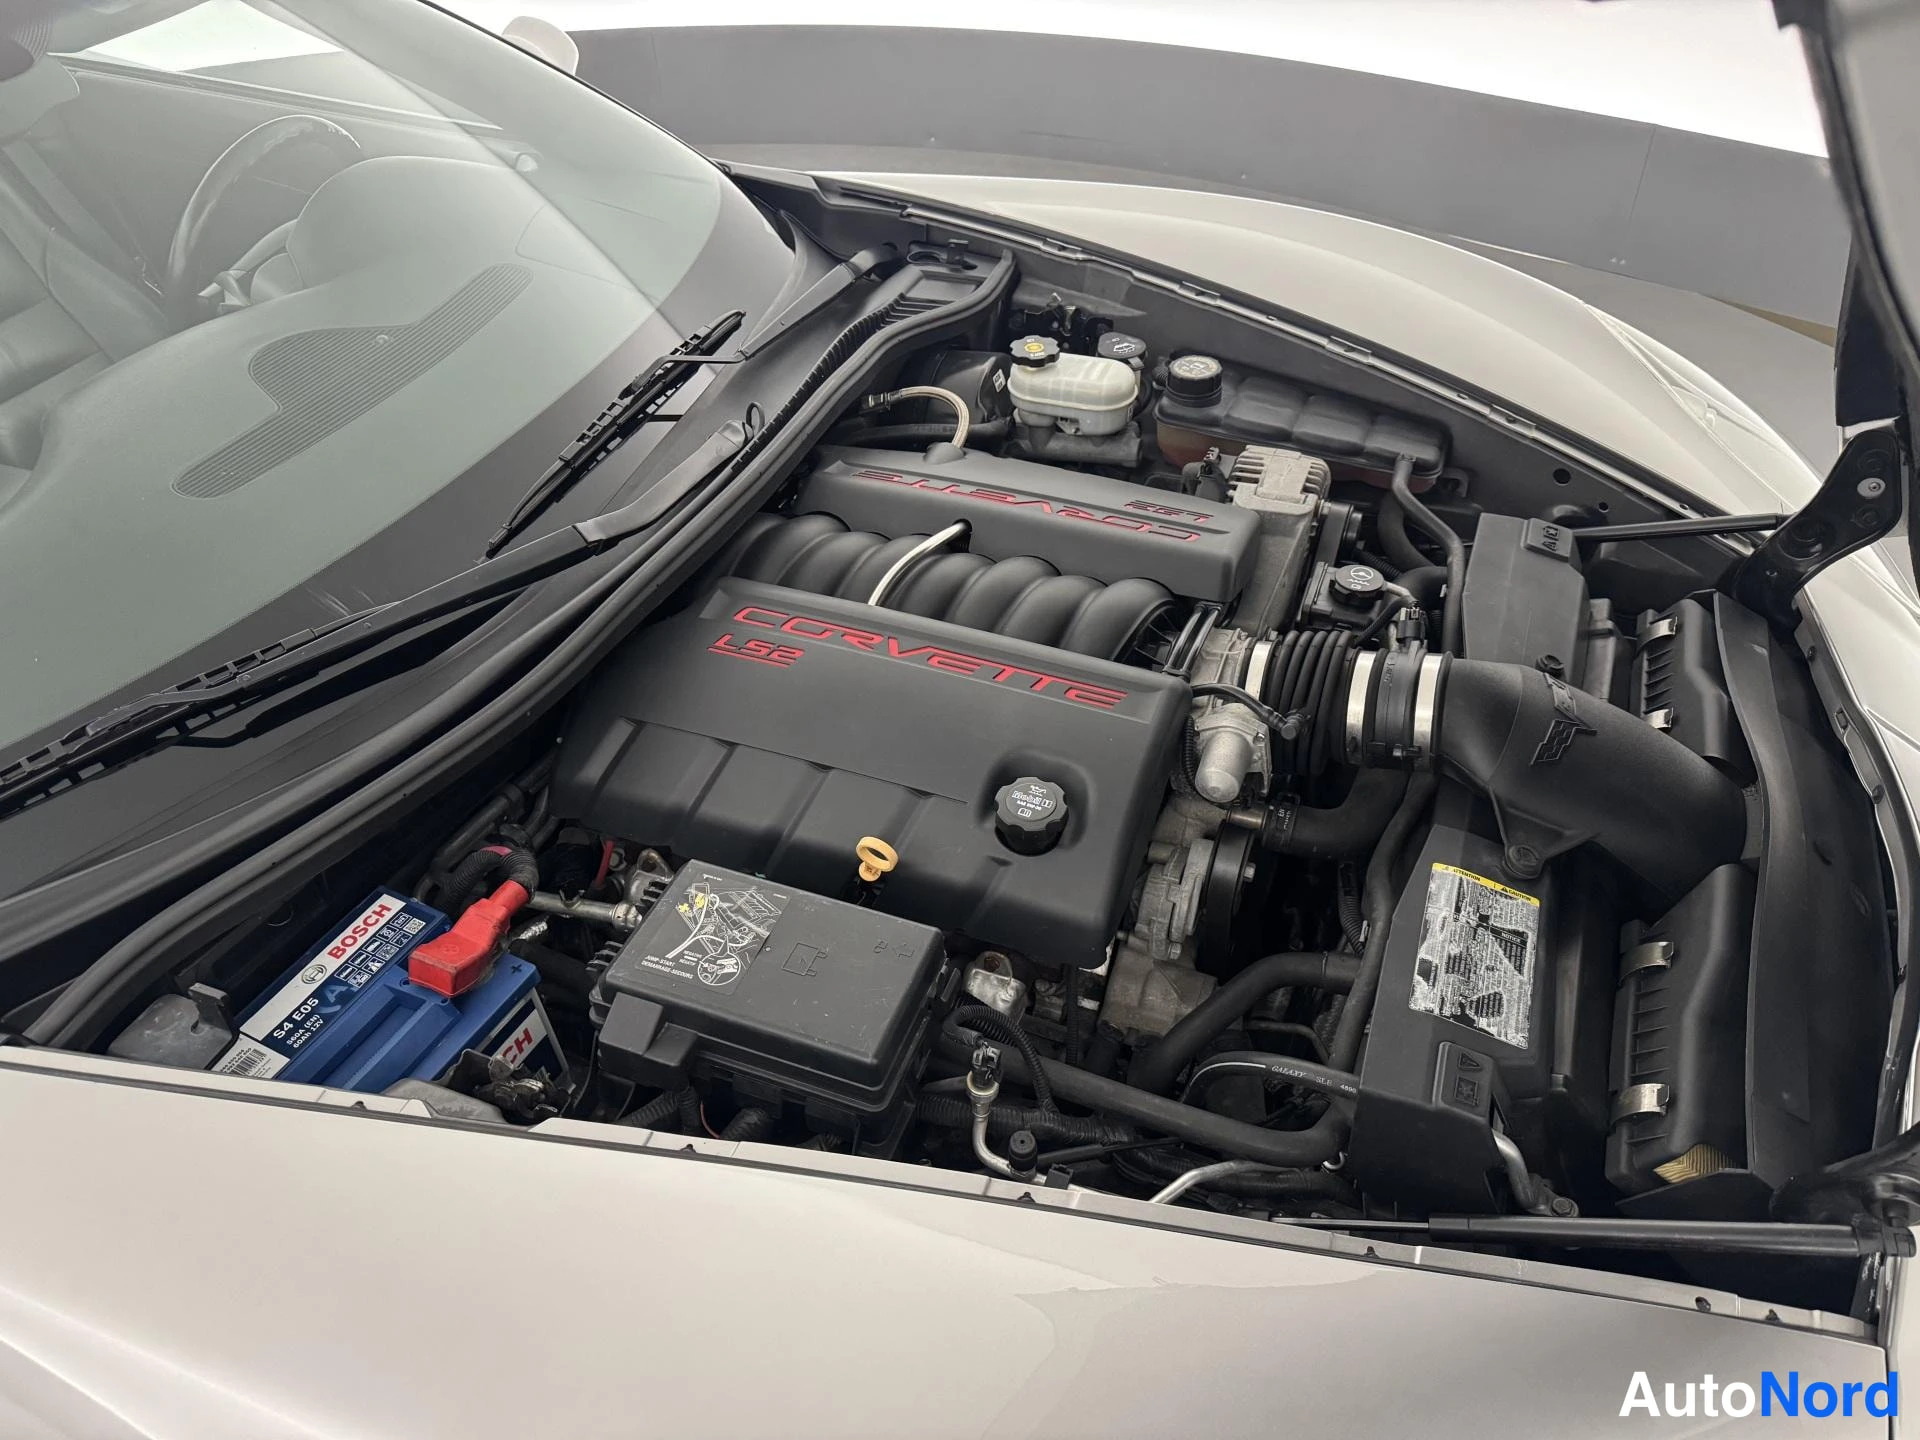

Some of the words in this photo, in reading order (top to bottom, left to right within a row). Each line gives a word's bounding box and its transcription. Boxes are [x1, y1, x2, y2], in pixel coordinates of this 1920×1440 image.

[851, 470, 1201, 542] CORVETTE
[709, 633, 805, 664] LS2
[733, 606, 1128, 709] CORVETTE
[1508, 889, 1532, 901] CAUTION
[327, 904, 392, 959] BOSCH
[273, 1022, 294, 1039] S4
[292, 997, 319, 1021] E05
[293, 1032, 312, 1048] 60Ah
[310, 1019, 324, 1031] 12V
